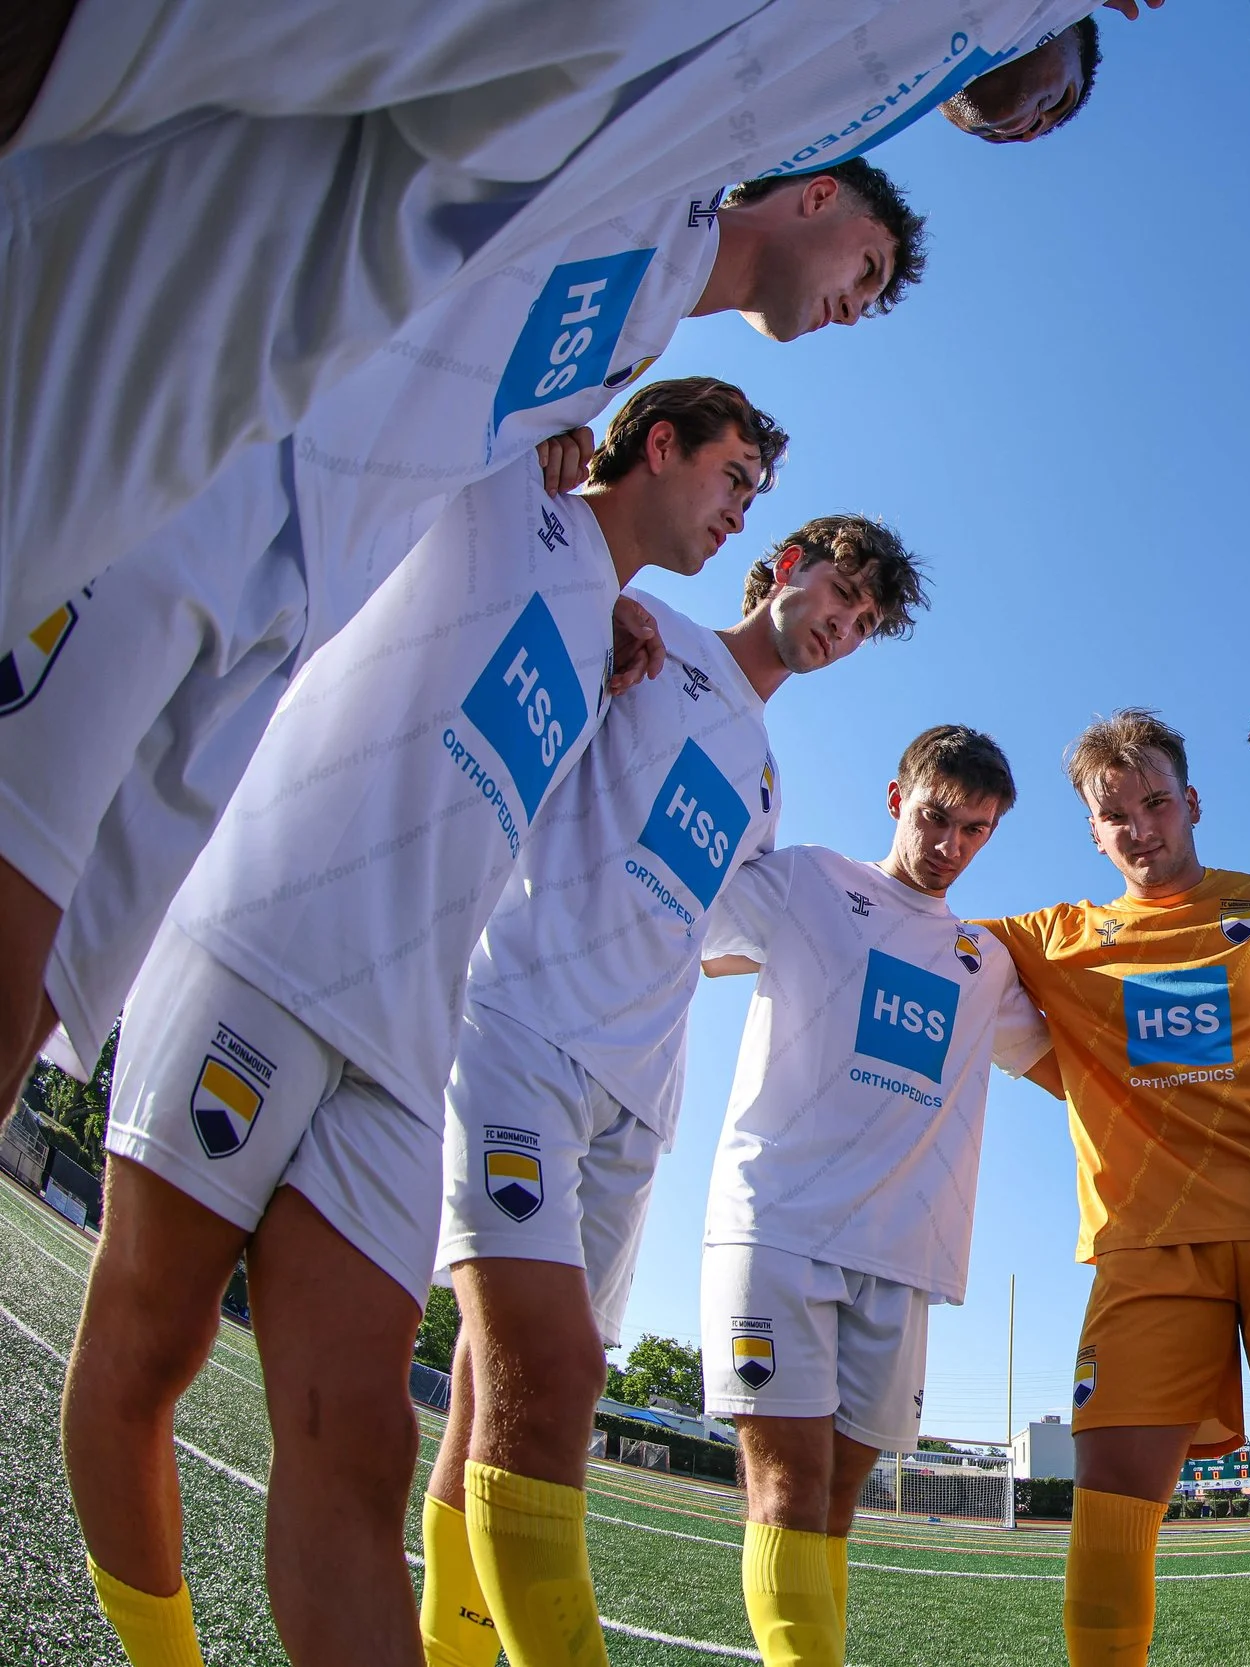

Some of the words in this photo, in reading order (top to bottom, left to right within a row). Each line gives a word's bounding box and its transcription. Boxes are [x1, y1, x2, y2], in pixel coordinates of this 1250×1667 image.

[535, 277, 608, 398] HSS
[502, 646, 562, 768] HSS
[442, 728, 521, 861] ORTHOPEDICS
[666, 784, 729, 868] HSS
[873, 988, 946, 1042] HSS
[1137, 1003, 1221, 1040] HSS
[216, 1030, 228, 1045] FC
[227, 1038, 273, 1081] MONMOUTH
[1129, 1068, 1236, 1089] ORTHOPEDICS
[849, 1068, 943, 1108] ORTHOPEDICS
[486, 1129, 495, 1139] FC
[497, 1130, 538, 1146] MONMOUTH
[739, 1320, 771, 1329] MONMOUTH
